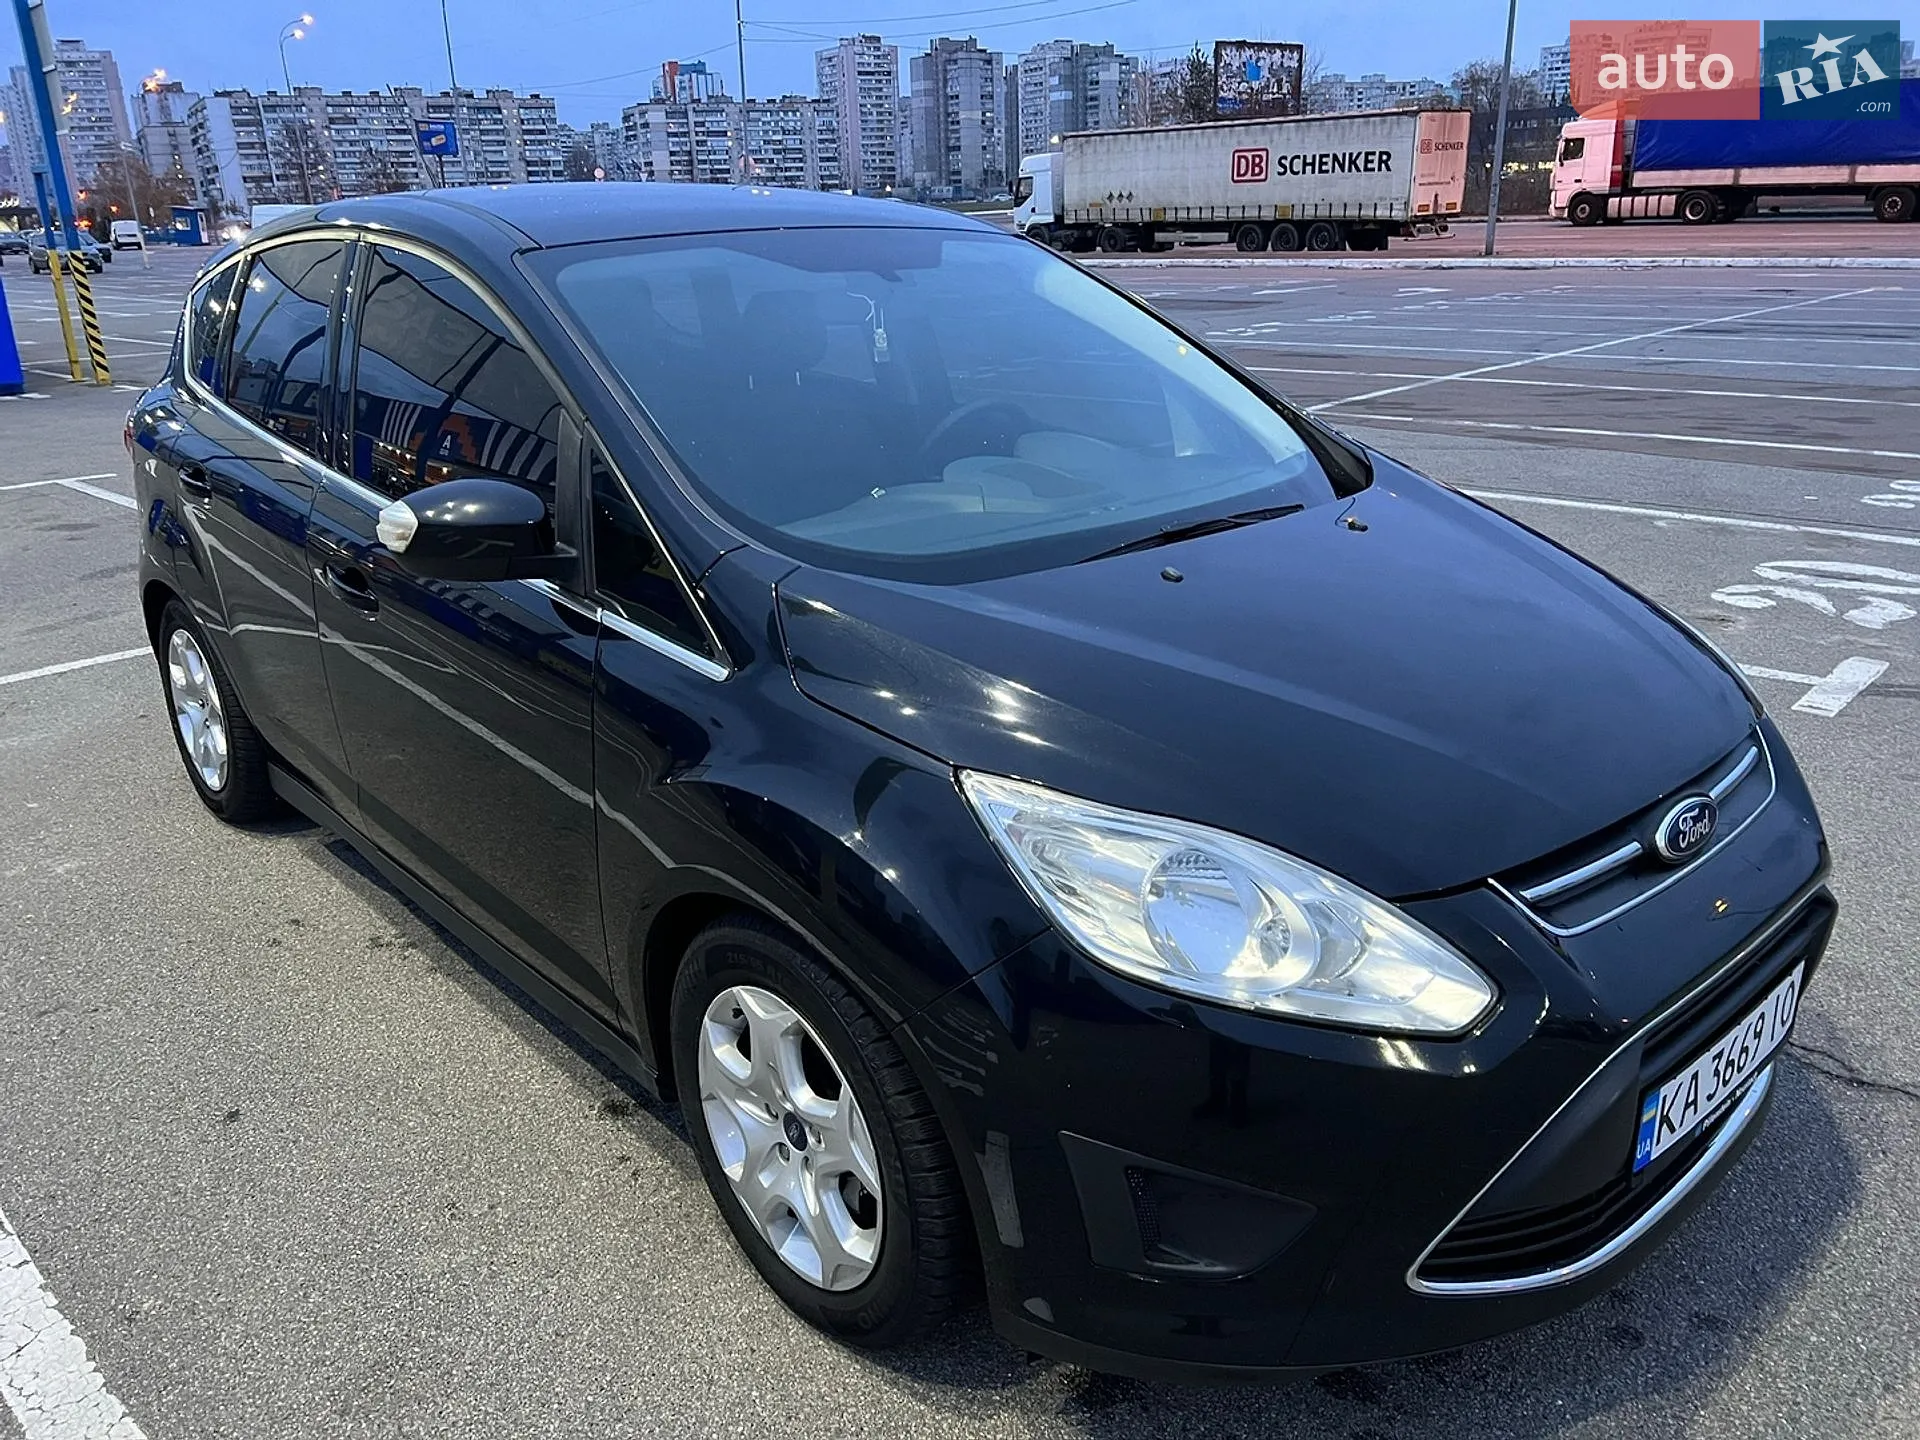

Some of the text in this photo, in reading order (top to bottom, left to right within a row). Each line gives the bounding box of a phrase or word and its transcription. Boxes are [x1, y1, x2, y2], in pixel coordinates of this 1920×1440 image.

[1434, 142, 1464, 151] SCHENKER
[1236, 150, 1392, 178] DB SCHENKER
[1679, 807, 1711, 849] Ford
[1656, 1069, 1699, 1147] KA
[1706, 1009, 1765, 1102] 3669
[1770, 980, 1795, 1042] IO
[1636, 1138, 1651, 1159] UA
